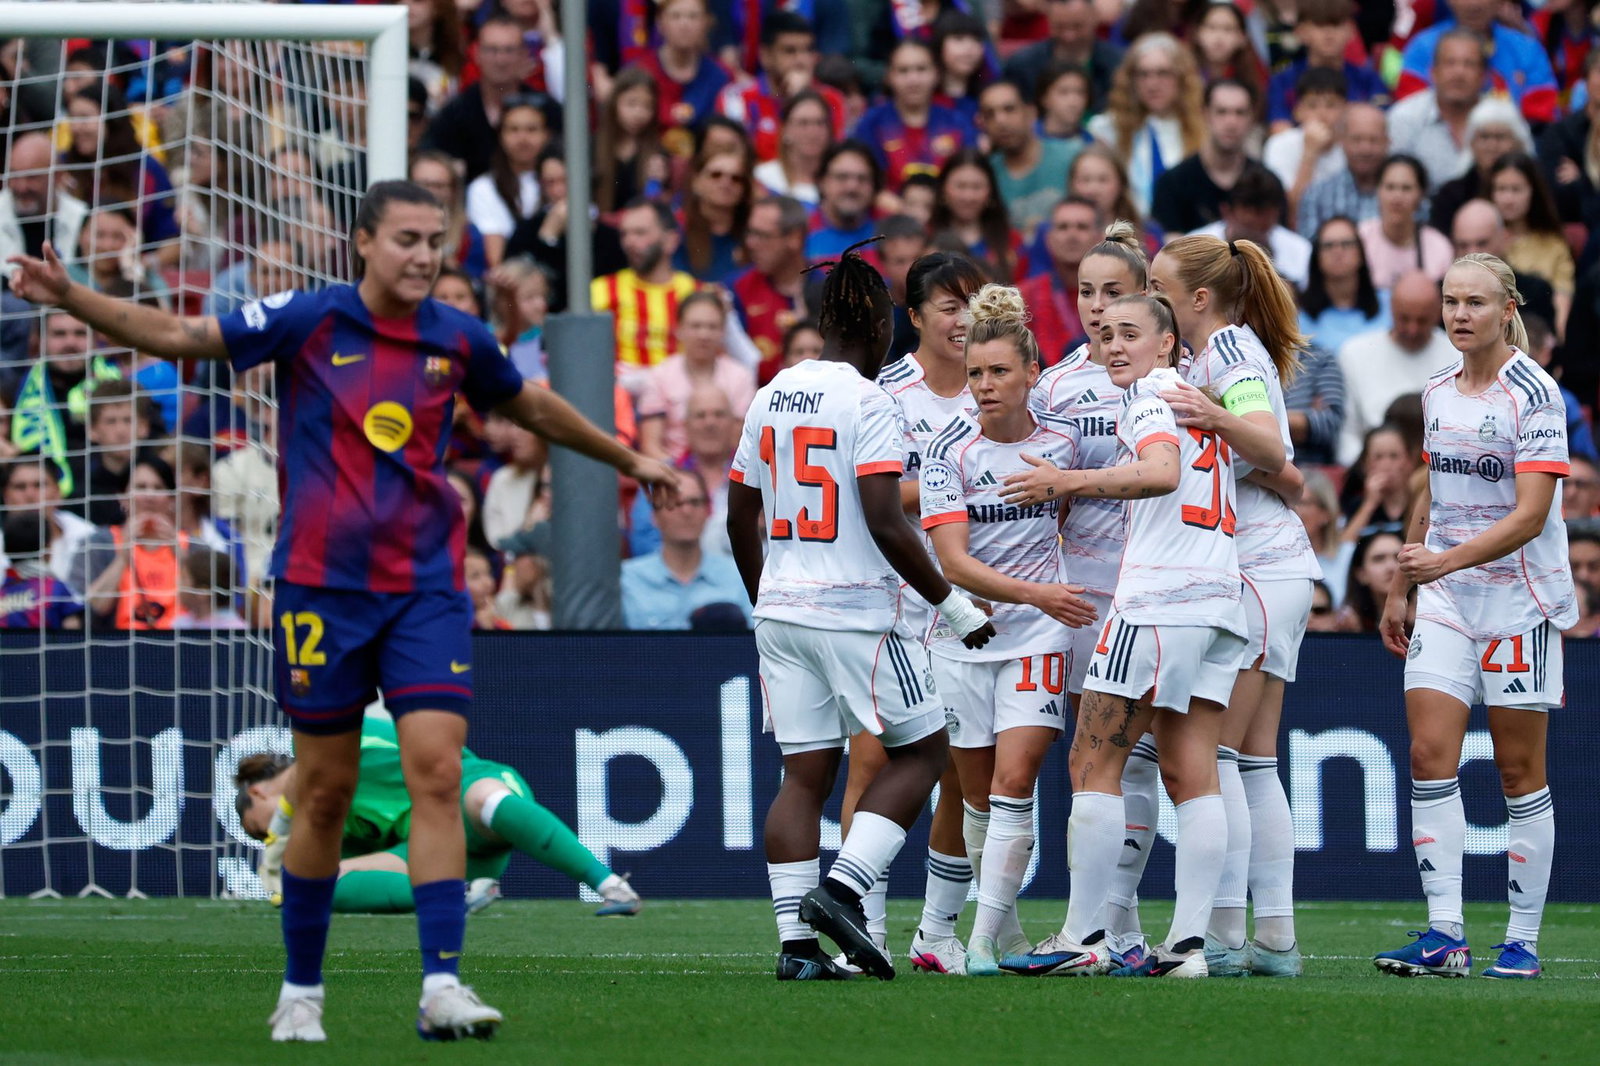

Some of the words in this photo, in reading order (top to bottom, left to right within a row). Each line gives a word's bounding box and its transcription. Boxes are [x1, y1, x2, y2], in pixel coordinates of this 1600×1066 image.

[769, 390, 824, 414] AMANI
[1134, 407, 1164, 425] ACHI
[1429, 451, 1472, 476] llianz
[759, 426, 839, 543] 15
[966, 503, 1045, 524] Allianz
[280, 611, 327, 666] 12
[1096, 617, 1113, 655] 1
[1480, 634, 1530, 672] 21
[1015, 652, 1065, 695] 10
